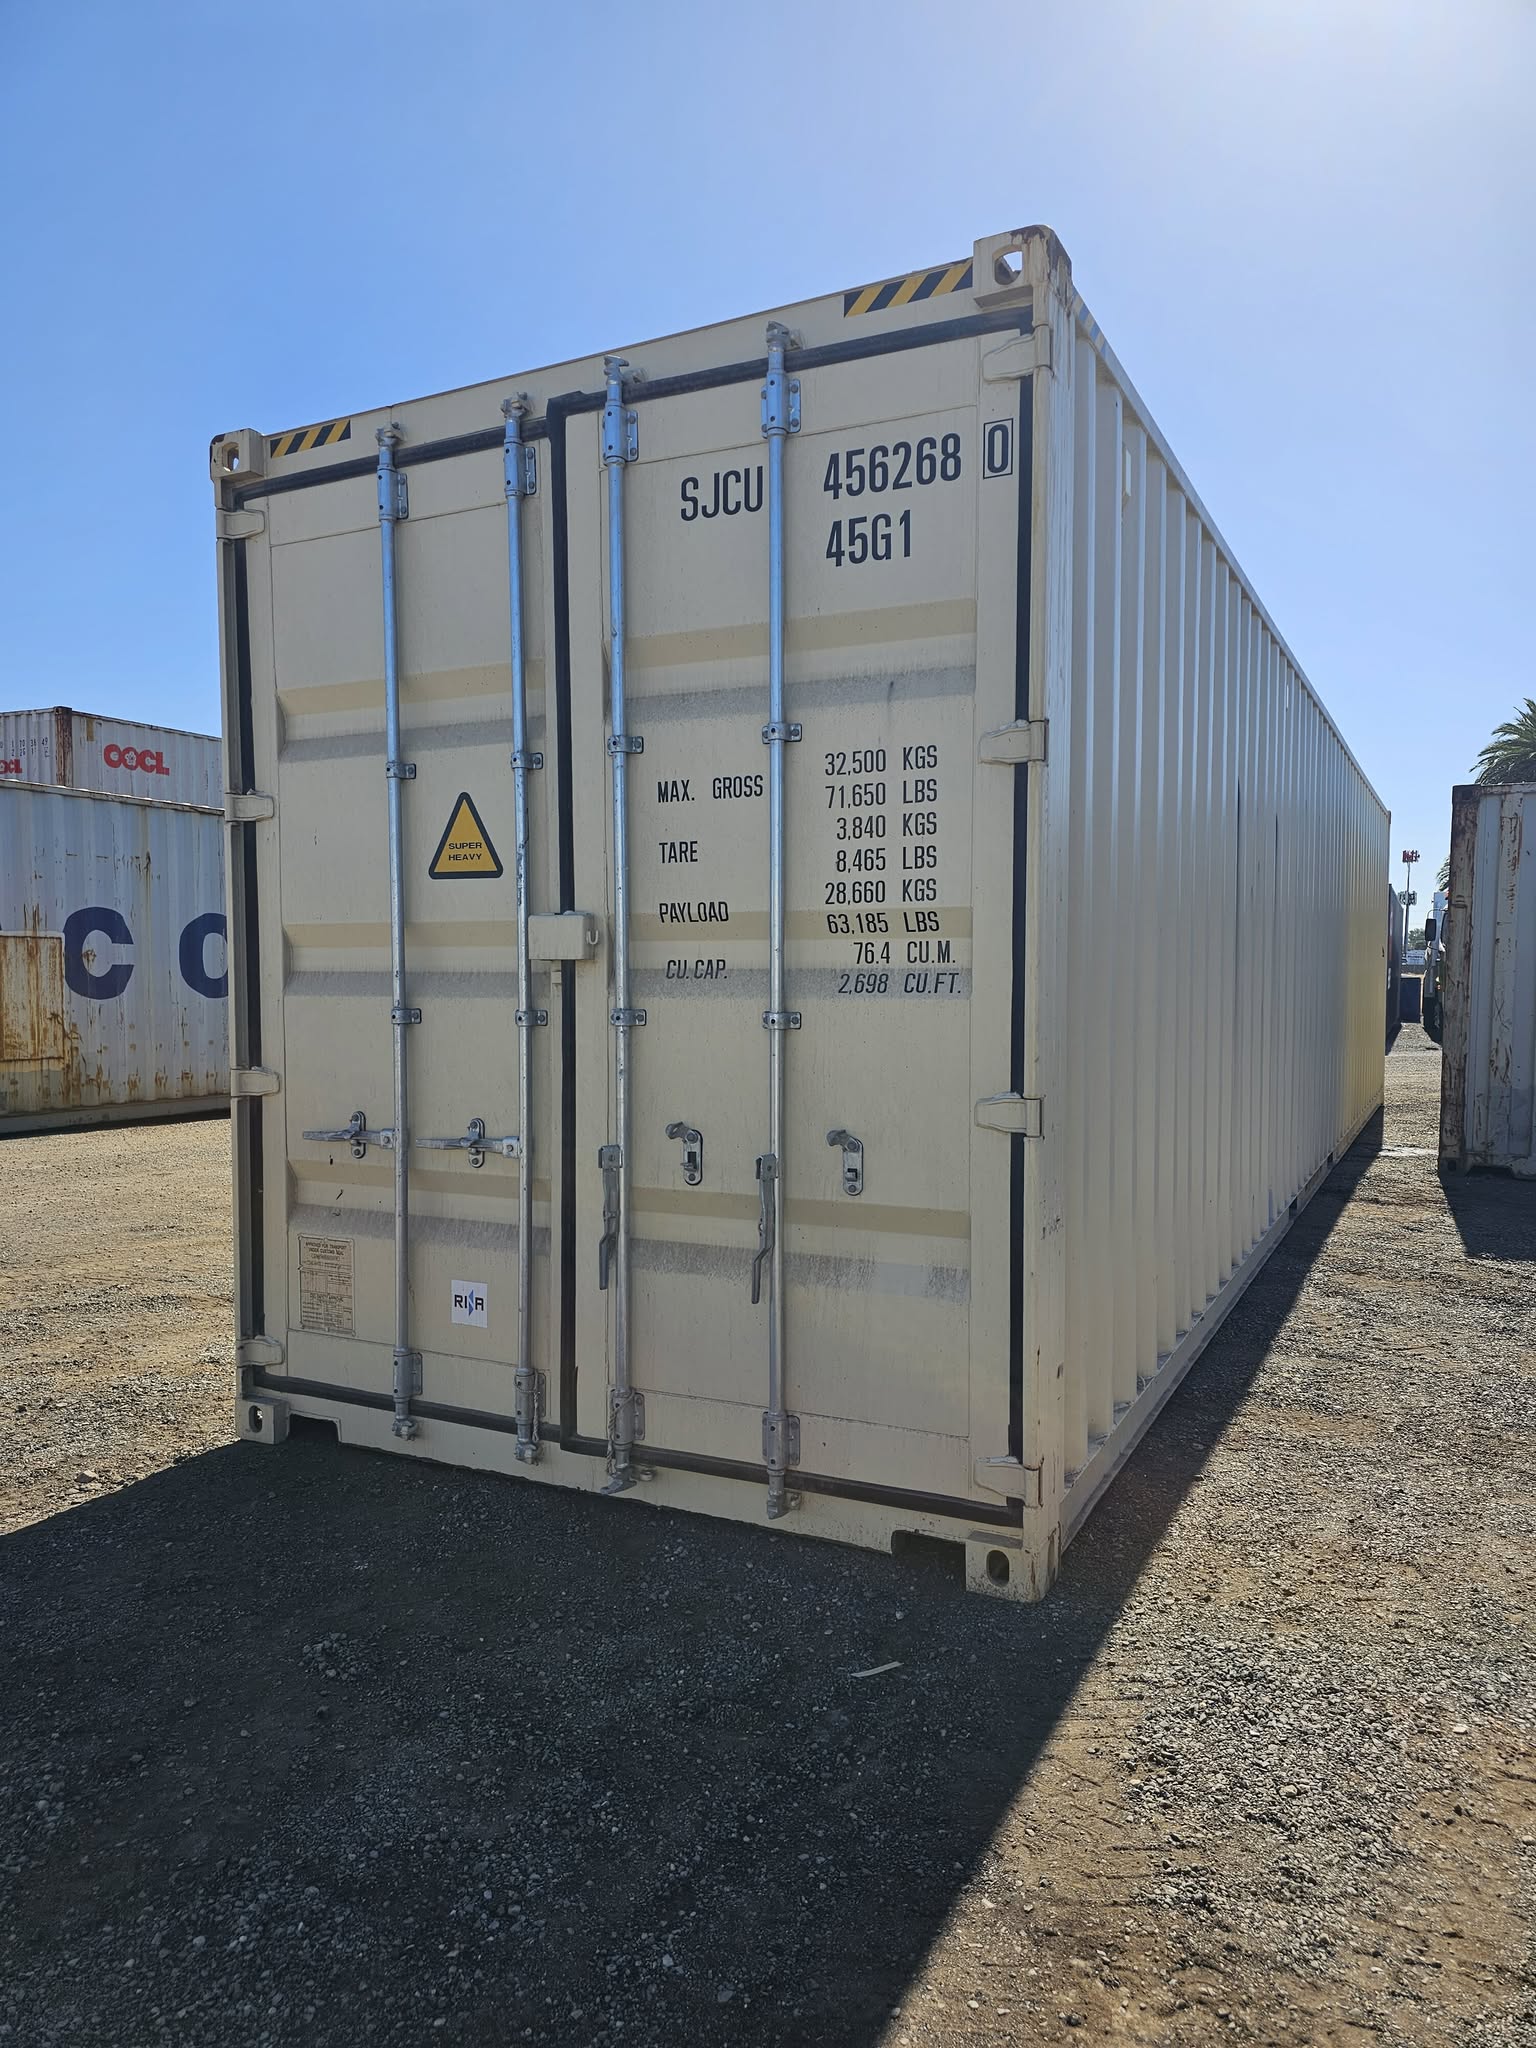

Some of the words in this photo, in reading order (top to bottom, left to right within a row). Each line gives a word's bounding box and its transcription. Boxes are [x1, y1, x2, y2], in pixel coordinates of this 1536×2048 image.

[680, 465, 763, 522] SJCU
[823, 432, 962, 501] 456268
[986, 422, 1011, 475] 0
[825, 509, 911, 568] 45G1
[104, 744, 170, 776] OOCL
[824, 748, 886, 776] 32,500
[902, 744, 938, 771] KGS
[657, 779, 695, 804] MAX.
[712, 774, 764, 800] GROSS
[824, 782, 886, 809] 71,650
[903, 778, 938, 804] LBS
[836, 814, 886, 841] 3,840
[902, 811, 937, 837] KGS
[448, 841, 483, 850] SUPER
[448, 853, 482, 862] HEAVY
[658, 840, 698, 864] TARE
[835, 847, 886, 873] 8,465
[902, 845, 937, 870] LBS
[825, 880, 886, 906] 28,660
[902, 878, 937, 903] KGS
[659, 901, 729, 924] PAYLOAD
[826, 912, 889, 935] 63,185
[903, 910, 940, 933] LBS
[853, 941, 891, 965] 76.4
[907, 940, 956, 964] CU.M.
[665, 959, 728, 980] CU.CAP.
[838, 973, 889, 995] 2,698
[903, 972, 963, 994] CU.FT.
